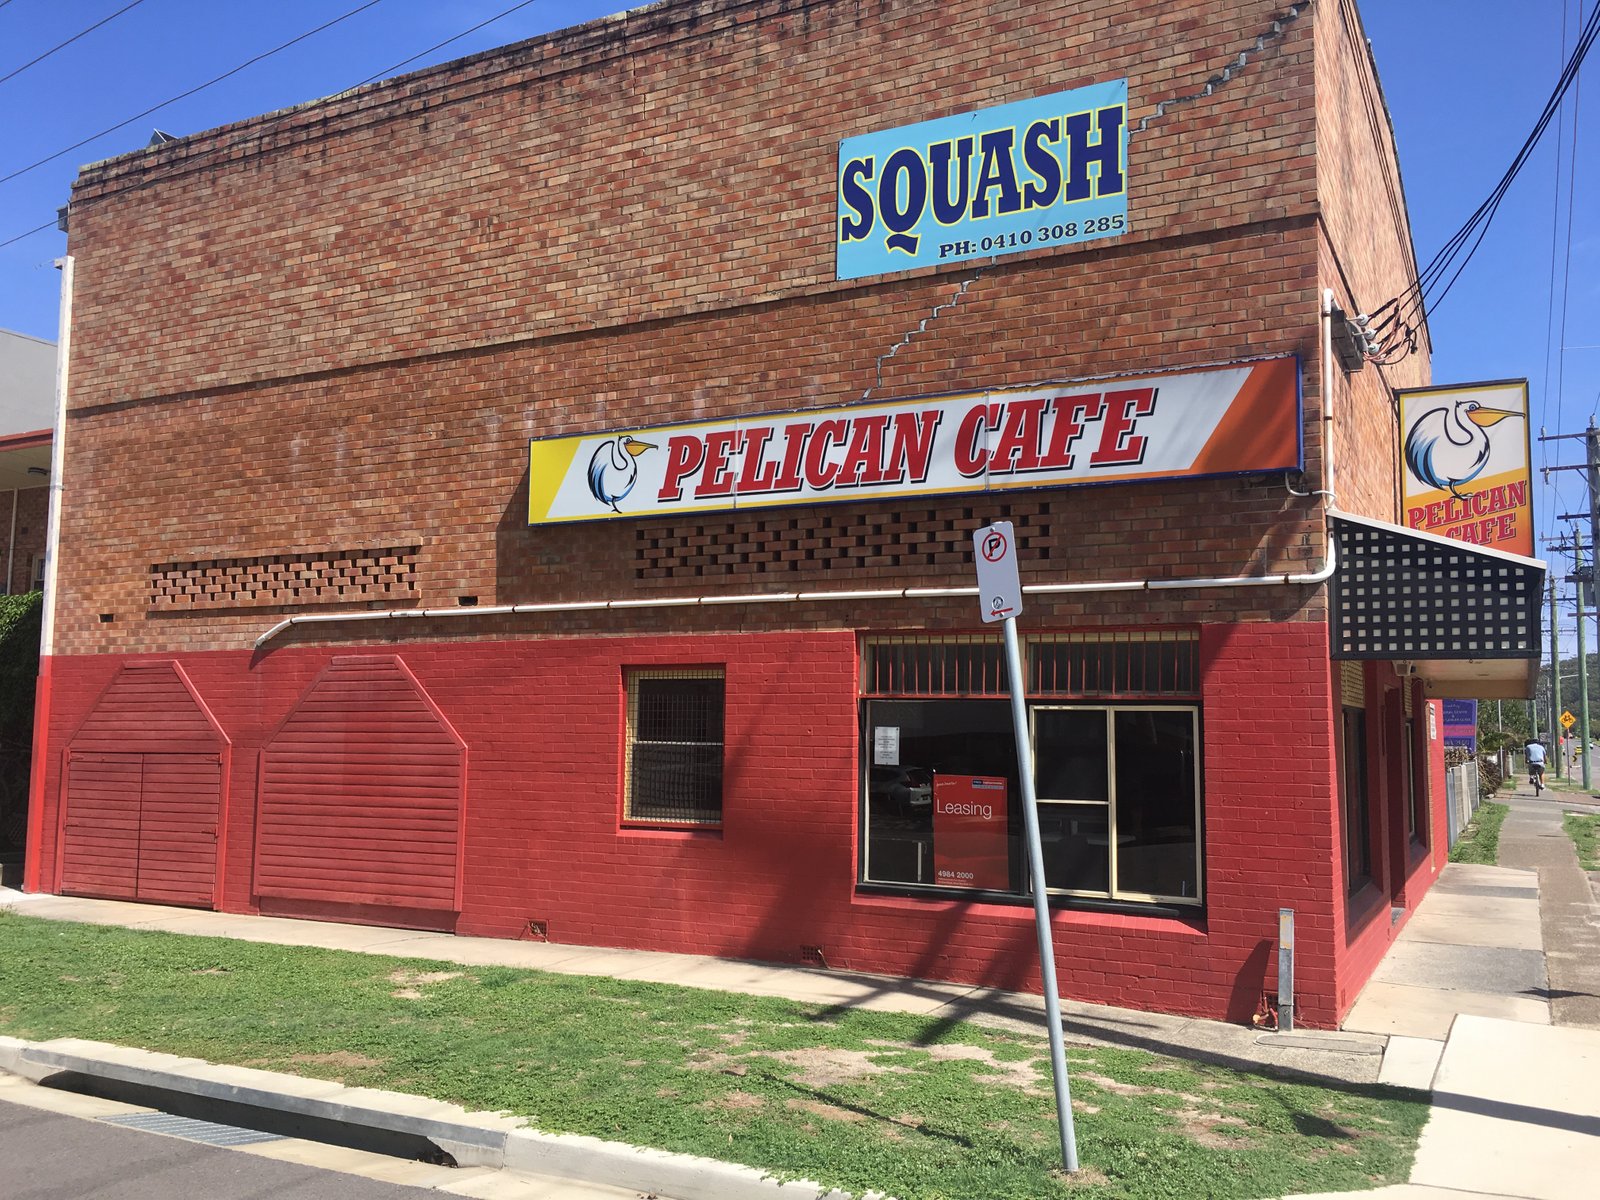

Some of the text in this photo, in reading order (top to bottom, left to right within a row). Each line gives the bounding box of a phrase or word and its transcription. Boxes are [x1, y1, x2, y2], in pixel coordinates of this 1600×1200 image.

[840, 103, 1126, 256] SQUASH
[939, 214, 1124, 258] PH: 0410 308 285
[657, 387, 1159, 503] PELICAN CAFE
[1407, 480, 1527, 531] PELICAN
[936, 799, 992, 820] Leasing
[938, 870, 955, 878] 4984
[956, 871, 974, 880] 2000
